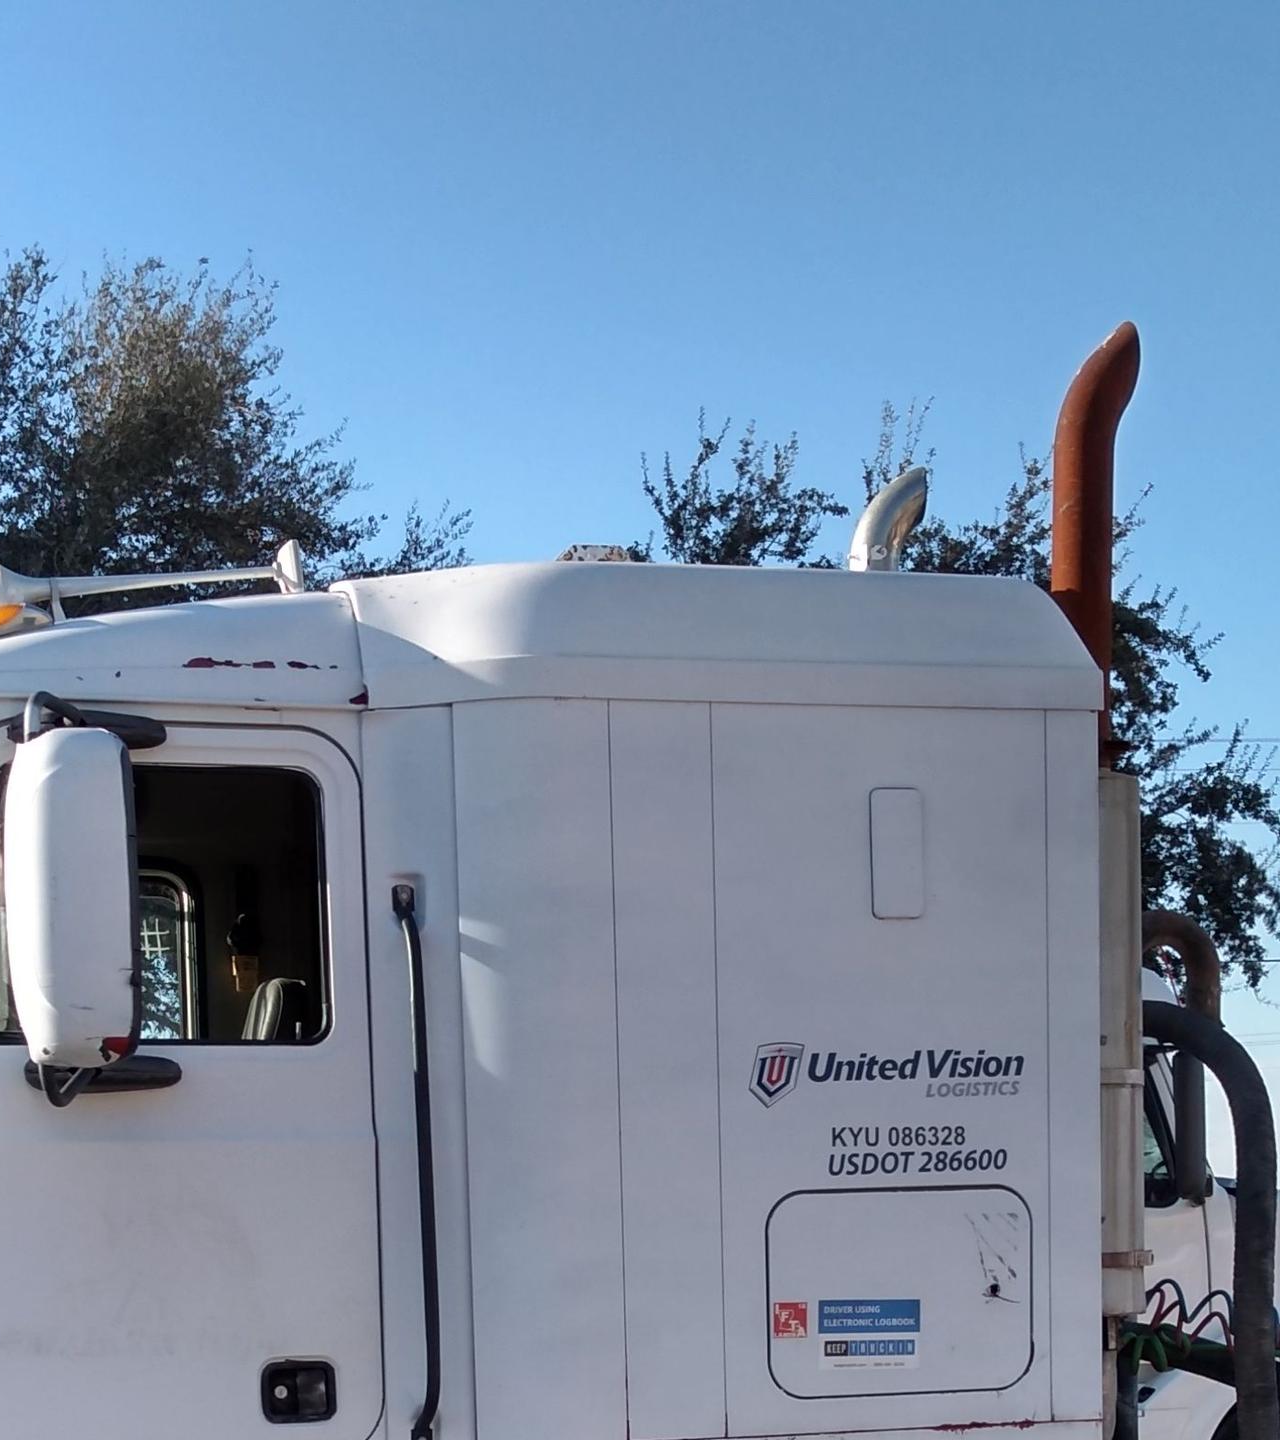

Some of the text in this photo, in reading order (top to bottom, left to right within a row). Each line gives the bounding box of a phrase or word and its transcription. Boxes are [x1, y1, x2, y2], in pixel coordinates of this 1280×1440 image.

[807, 1050, 1024, 1082] United Vision
[925, 1081, 1021, 1098] LOGISTICS
[831, 1126, 966, 1147] KYU 086328
[828, 1149, 1008, 1176] USDOT 286600
[823, 1305, 880, 1314] DRIVER USING
[823, 1318, 916, 1327] ELECTRONIC LOGBOOK
